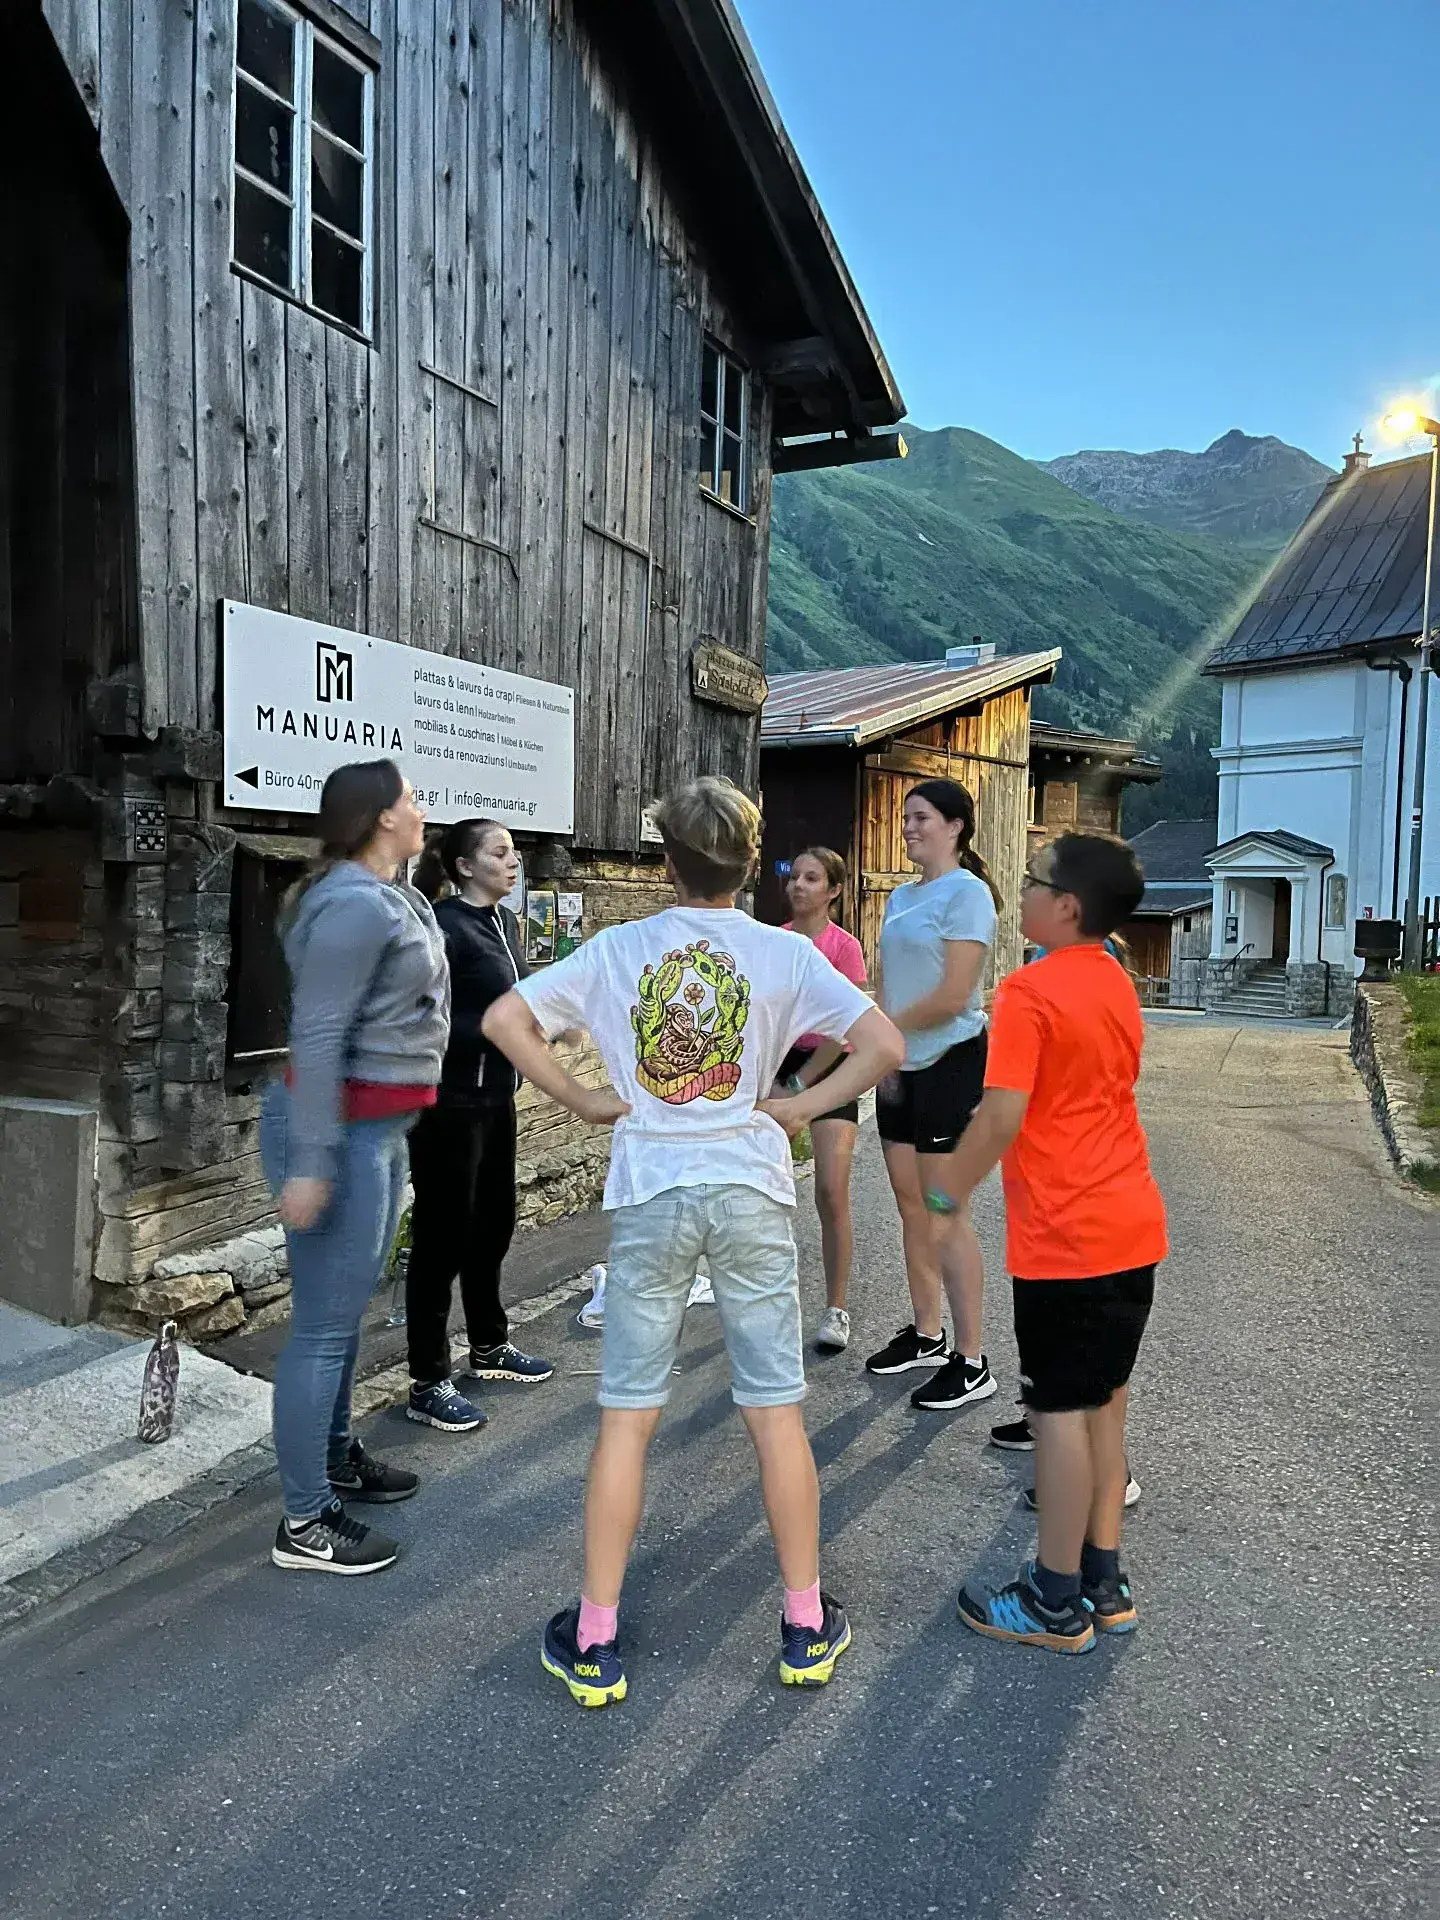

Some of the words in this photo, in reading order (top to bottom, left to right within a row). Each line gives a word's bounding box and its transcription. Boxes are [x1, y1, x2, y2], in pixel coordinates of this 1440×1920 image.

[414, 667, 446, 687] plattas
[448, 675, 455, 689] &
[456, 677, 482, 696] lavurs
[483, 684, 494, 698] da
[515, 694, 536, 708] Fliesen
[537, 698, 542, 709] &
[542, 701, 570, 715] Naturstein
[414, 691, 442, 710] lavurs
[443, 699, 454, 712] da
[478, 708, 516, 725] Holzarbeiten
[256, 704, 403, 751] MANUARIA
[414, 718, 448, 734] mobilias
[449, 724, 456, 736] &
[458, 726, 495, 744] cuschinas
[501, 735, 518, 748] Möbel
[518, 739, 523, 749] &
[524, 740, 544, 753] Küchen
[414, 741, 442, 758] lavurs
[443, 746, 454, 760] da
[456, 751, 505, 768] renovaziuns
[508, 759, 538, 772] Umbauten
[265, 770, 295, 788] Büro
[454, 789, 538, 816] info@manuaria.gr
[574, 1662, 602, 1678] HOKA
